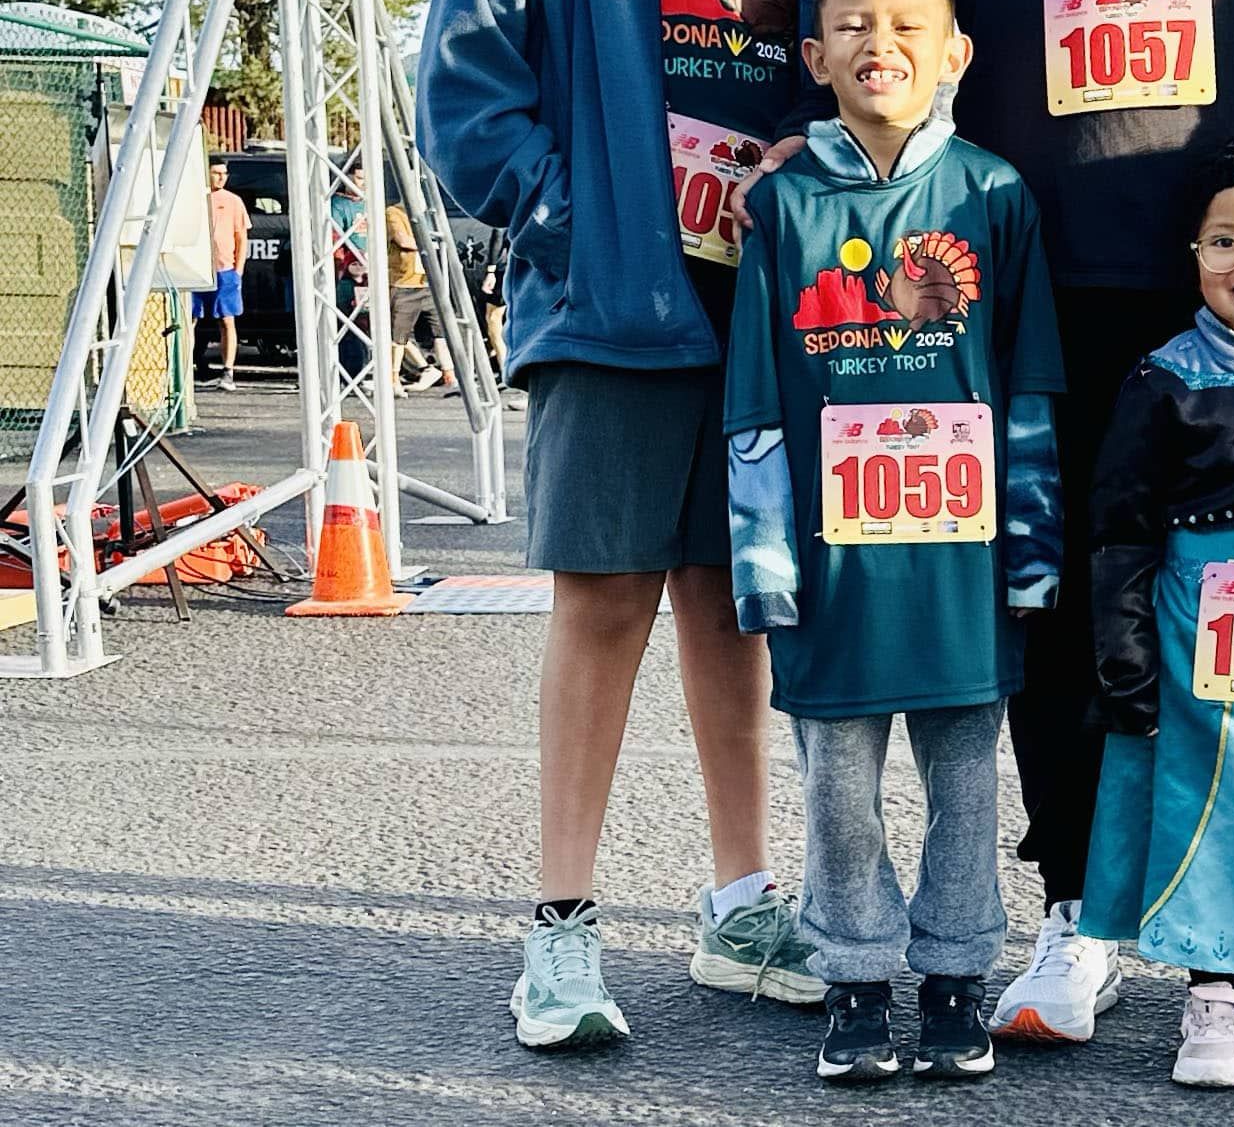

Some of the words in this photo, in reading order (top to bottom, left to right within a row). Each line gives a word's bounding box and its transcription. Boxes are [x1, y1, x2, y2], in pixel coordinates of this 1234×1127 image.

[755, 41, 787, 64] 2025
[1059, 20, 1196, 88] 1057
[731, 61, 776, 83] TROT
[805, 326, 883, 356] SEDONA
[915, 331, 954, 348] 2025
[827, 355, 888, 376] TURKEY
[892, 352, 938, 372] TROT
[832, 453, 983, 519] 1059
